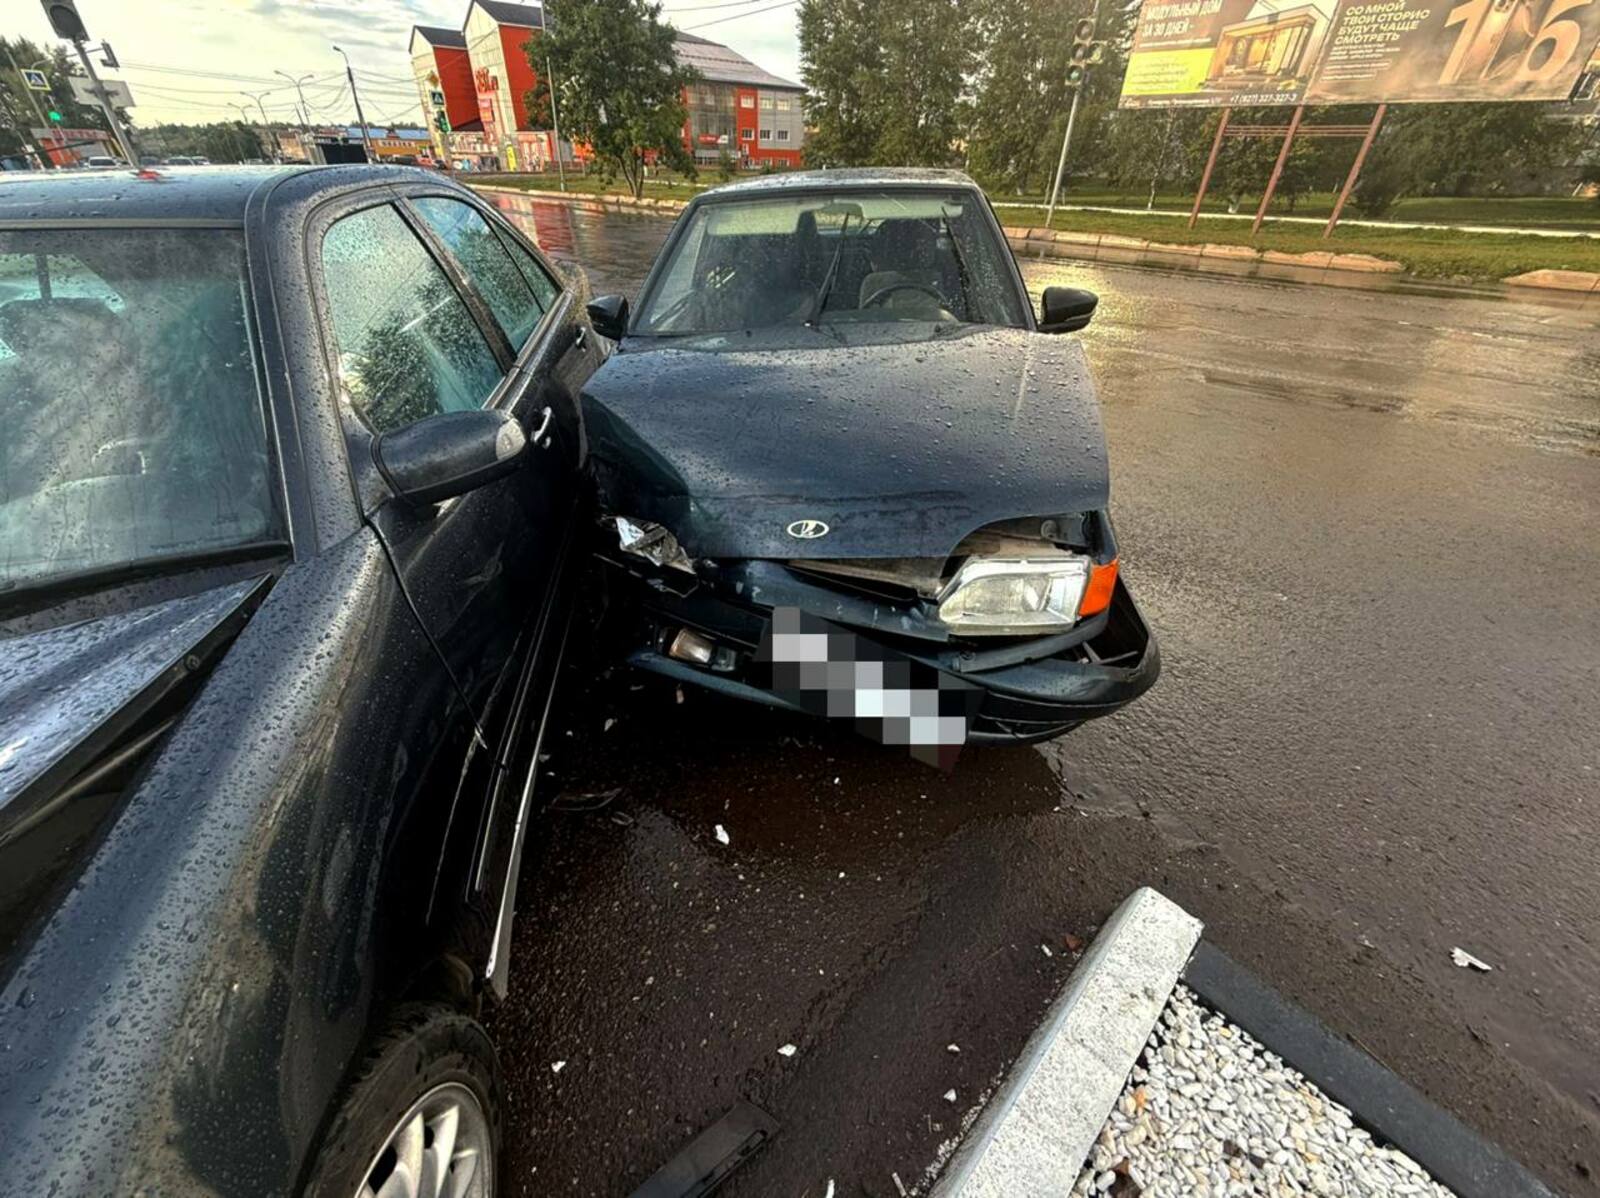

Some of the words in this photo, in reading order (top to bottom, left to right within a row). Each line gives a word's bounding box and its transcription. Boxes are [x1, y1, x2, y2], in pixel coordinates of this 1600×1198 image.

[1346, 6, 1364, 16] СО
[1365, 0, 1406, 14] МНОЙ
[1343, 15, 1375, 25] ТВОИ
[1377, 9, 1430, 22] СТОРИС
[1338, 24, 1378, 36] БУДУТ
[1379, 20, 1420, 32] ЧАЩЕ
[1334, 32, 1400, 45] СМОТРЕТЬ
